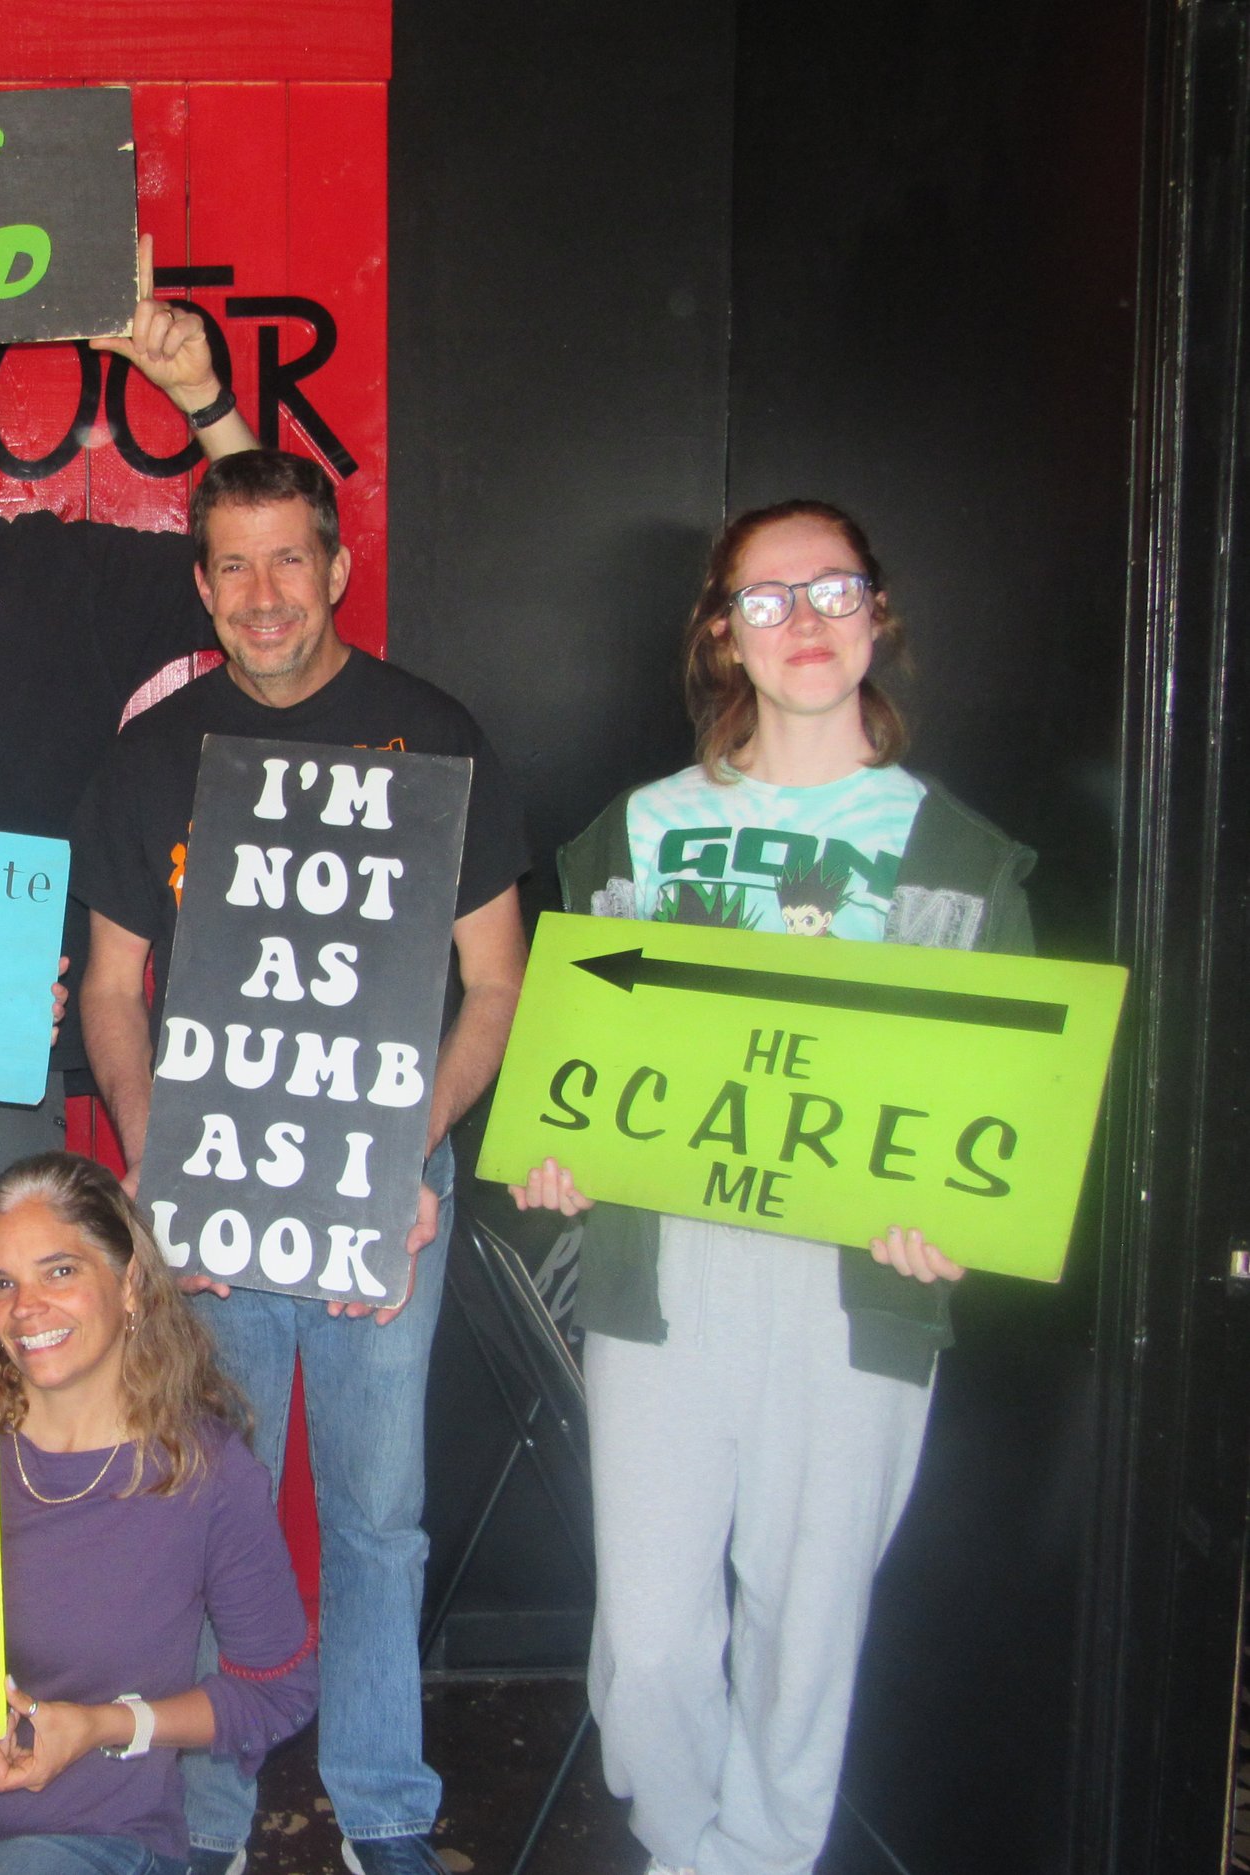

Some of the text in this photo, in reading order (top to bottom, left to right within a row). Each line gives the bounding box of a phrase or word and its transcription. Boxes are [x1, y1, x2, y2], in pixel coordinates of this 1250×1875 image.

[254, 759, 393, 829] I'M
[226, 845, 403, 920] NOT
[658, 827, 901, 899] GON
[241, 937, 358, 1006] AS
[154, 1017, 424, 1107] DUMB
[743, 1029, 818, 1080] HE
[183, 1114, 373, 1198] AS I
[539, 1058, 1018, 1198] SCARES
[704, 1162, 791, 1217] ME
[151, 1201, 387, 1297] LOOK
